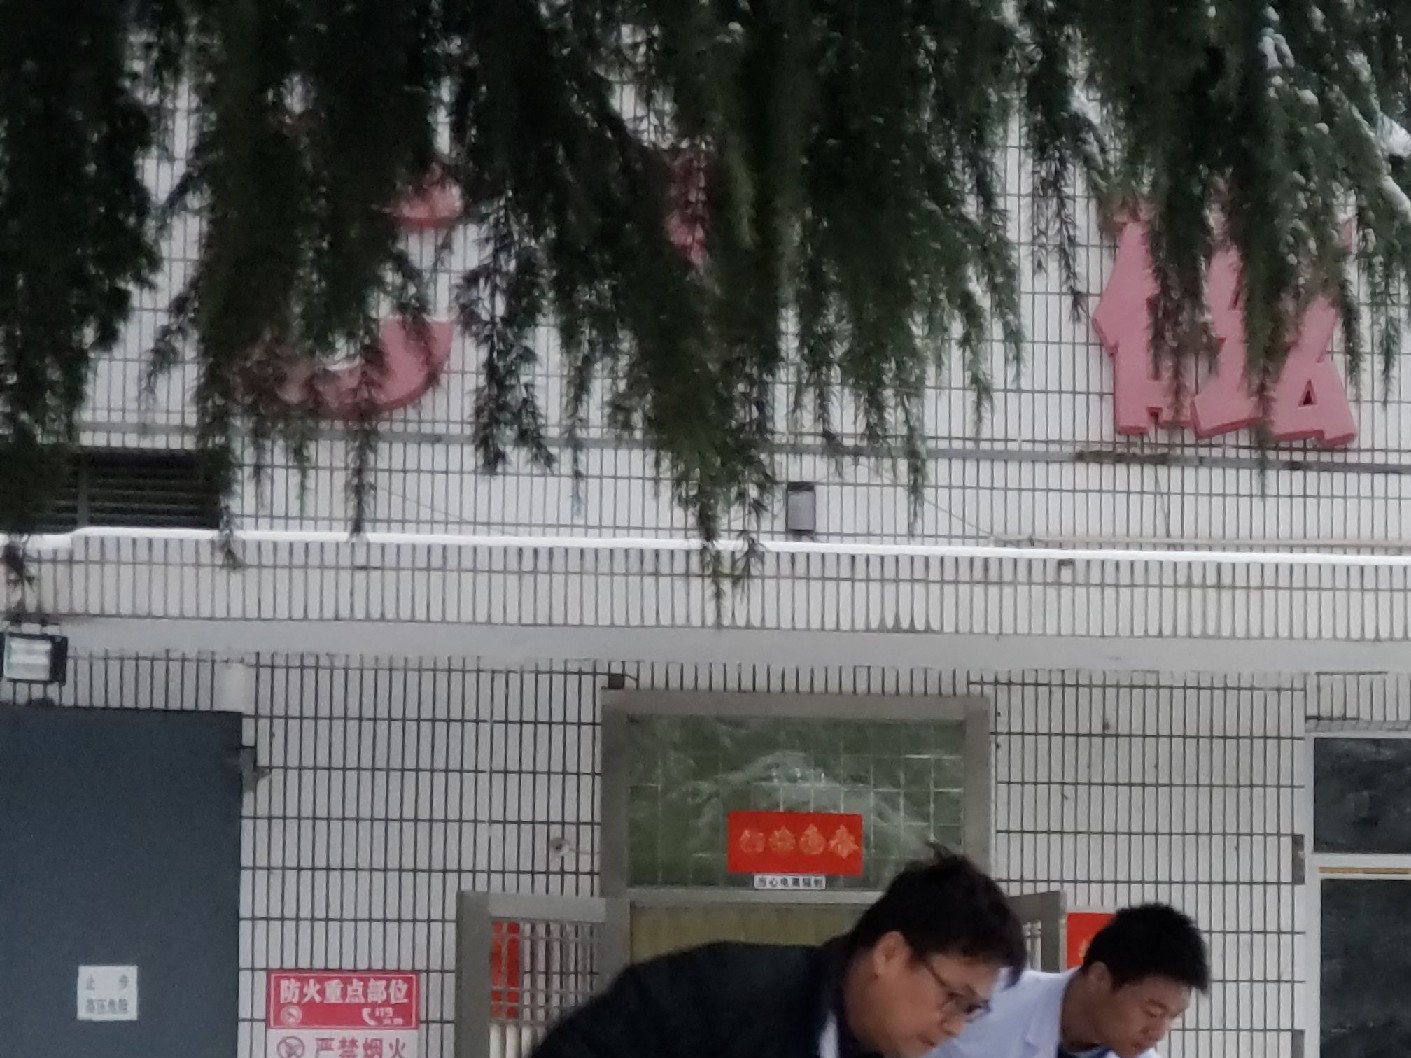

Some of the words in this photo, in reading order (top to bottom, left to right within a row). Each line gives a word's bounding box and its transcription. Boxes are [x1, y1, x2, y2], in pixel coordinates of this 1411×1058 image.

[280, 978, 409, 1004] 防火重点部位
